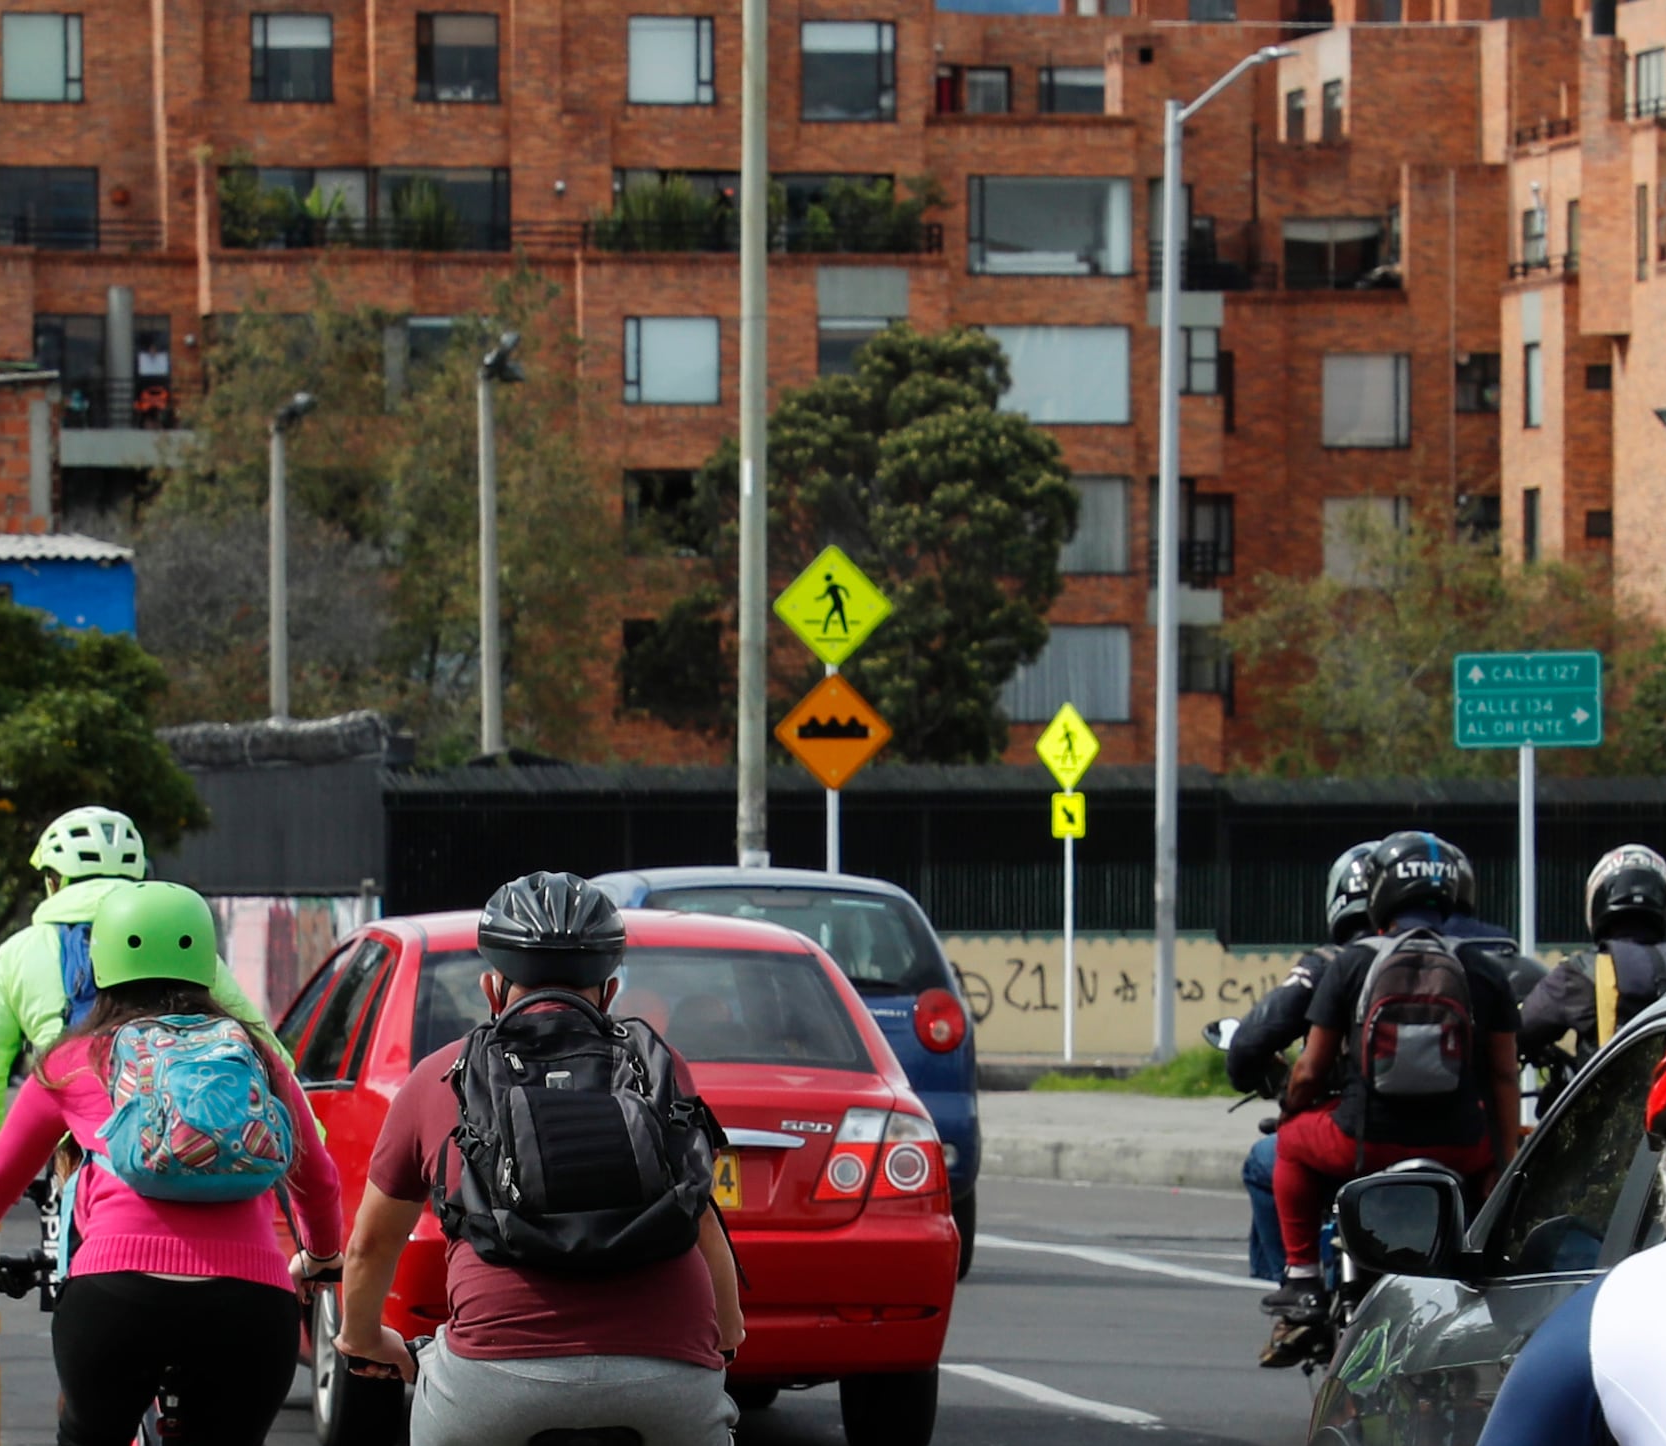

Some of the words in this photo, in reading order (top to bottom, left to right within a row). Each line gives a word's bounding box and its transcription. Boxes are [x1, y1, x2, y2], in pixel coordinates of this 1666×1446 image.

[1491, 665, 1547, 681] CALLE
[1553, 665, 1580, 680] 127
[1465, 700, 1520, 715] CALLE
[1527, 699, 1553, 713] 134
[1467, 721, 1487, 736] AL
[1493, 720, 1565, 736] ORIENTE
